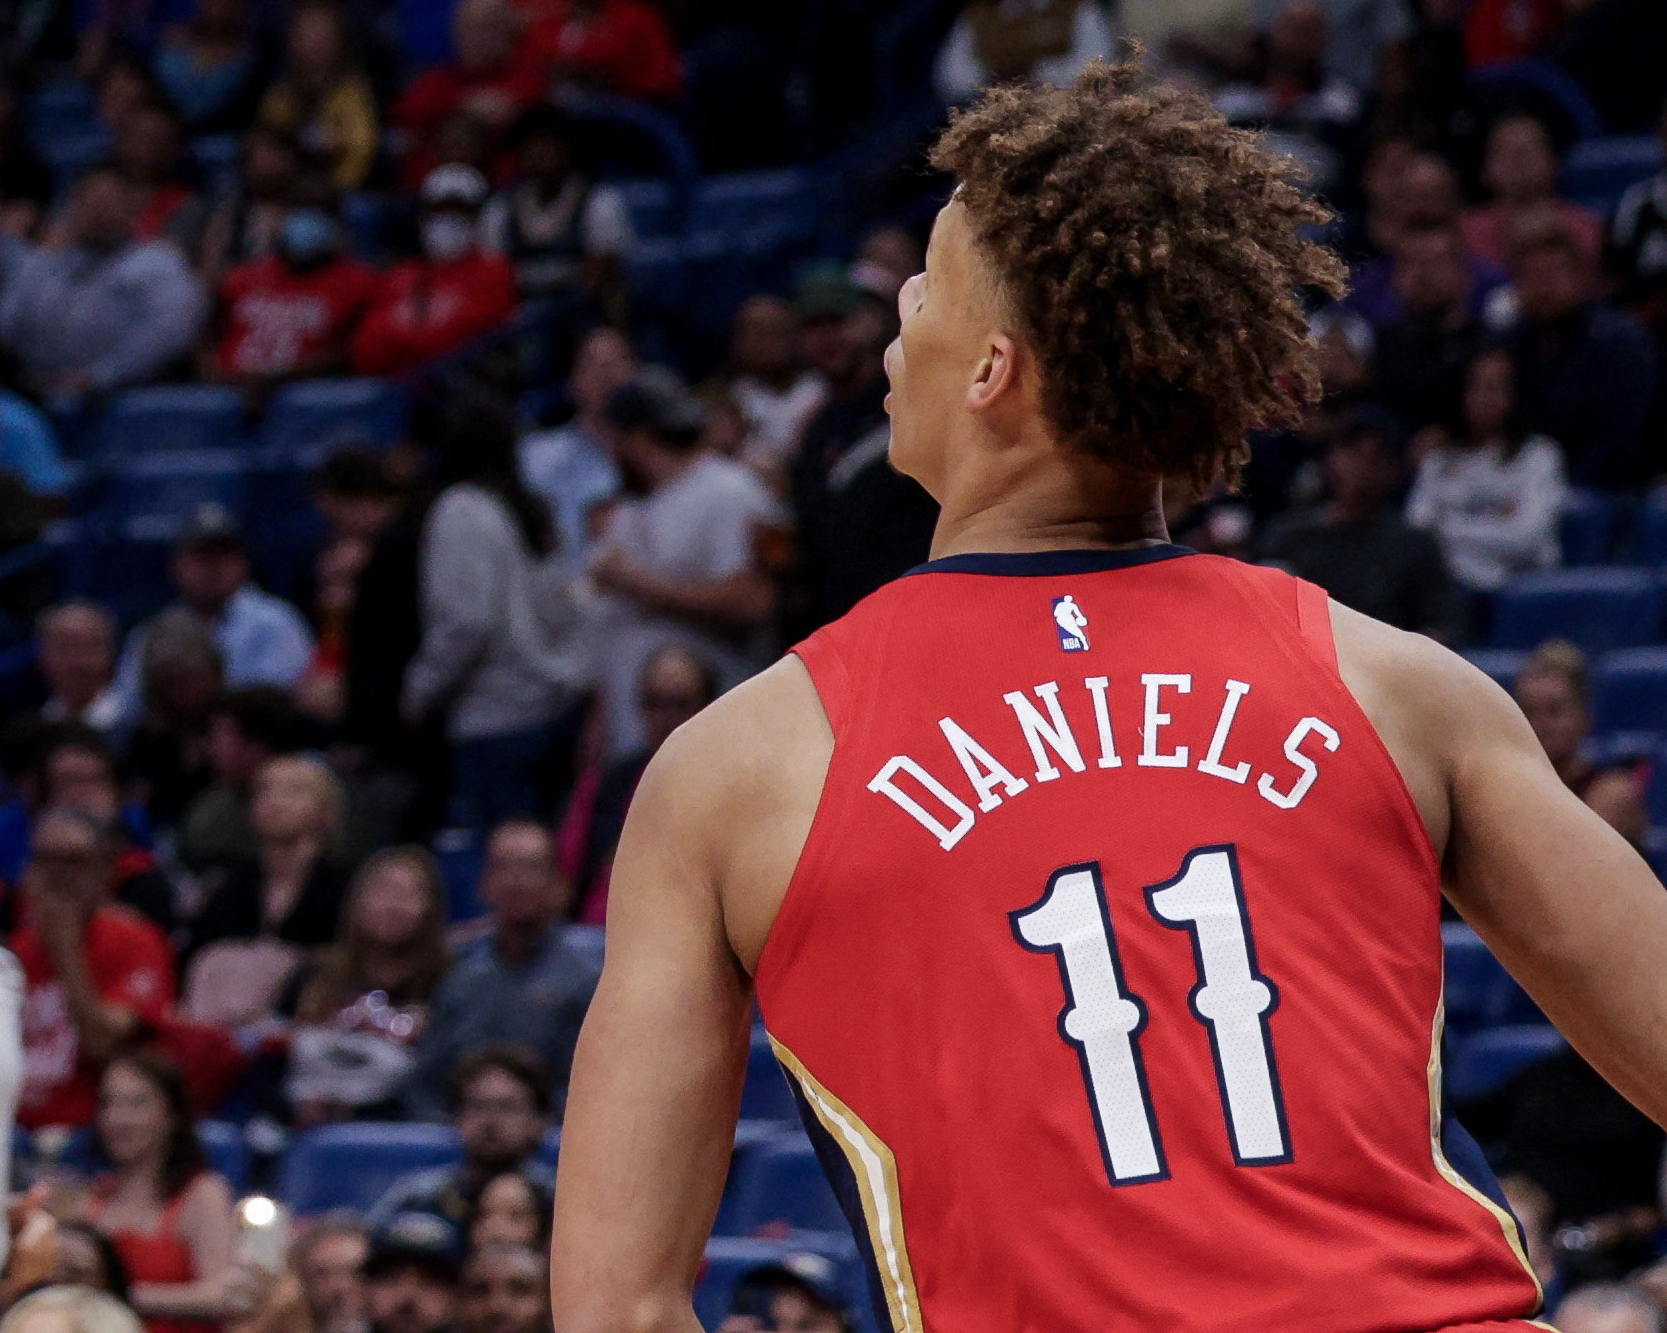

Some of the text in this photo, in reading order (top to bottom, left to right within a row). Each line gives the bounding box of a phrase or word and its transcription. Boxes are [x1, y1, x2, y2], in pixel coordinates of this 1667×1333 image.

[1062, 637, 1082, 650] NBA
[866, 672, 1342, 852] DANIELS
[1008, 843, 1295, 1187] 11
